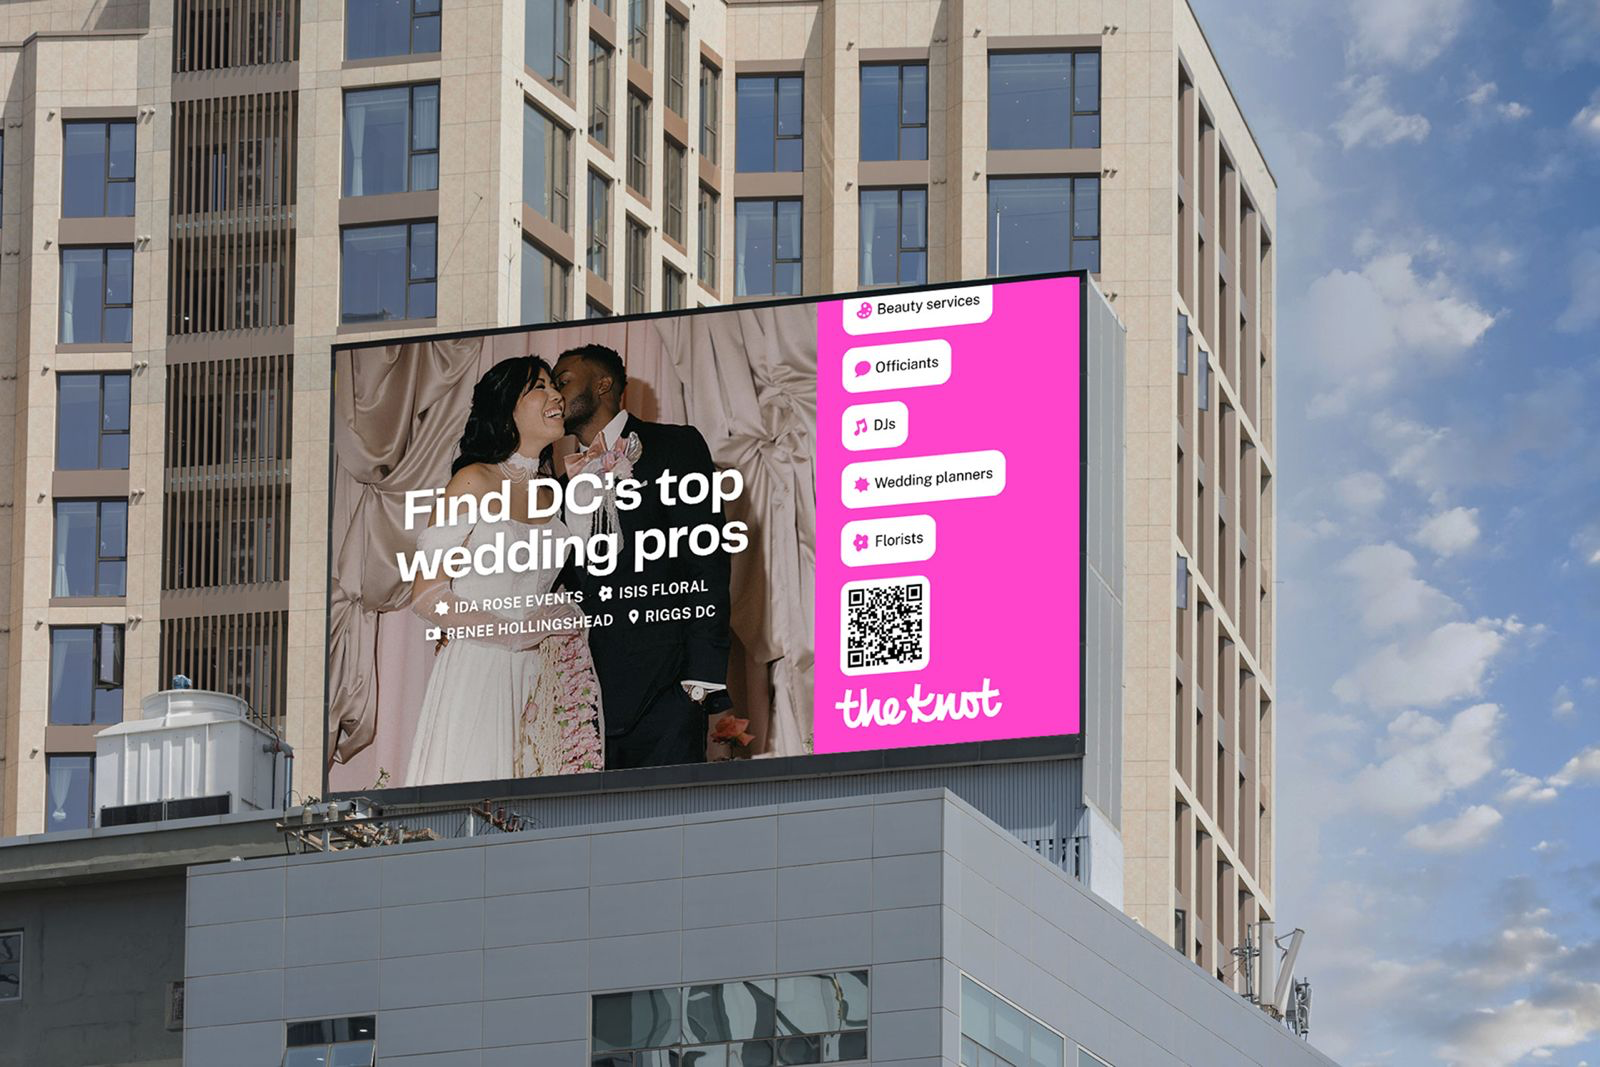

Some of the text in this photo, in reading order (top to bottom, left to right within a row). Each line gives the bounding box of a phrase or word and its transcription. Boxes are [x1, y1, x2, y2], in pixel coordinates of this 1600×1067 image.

[877, 294, 980, 315] Beauty services
[875, 357, 939, 373] Officiants
[874, 418, 896, 432] DJs
[875, 468, 993, 489] Wedding planners
[404, 480, 511, 530] Find
[655, 468, 744, 513] top
[875, 532, 924, 547] Florists
[396, 520, 749, 582] wedding pros
[619, 580, 709, 599] ISIS FLORAL
[454, 591, 584, 614] IDA ROSE EVENTS
[645, 605, 716, 623] RIGGS DC
[447, 614, 614, 640] RENEE HOLLINGSHEAD
[835, 677, 1003, 729] the knot
